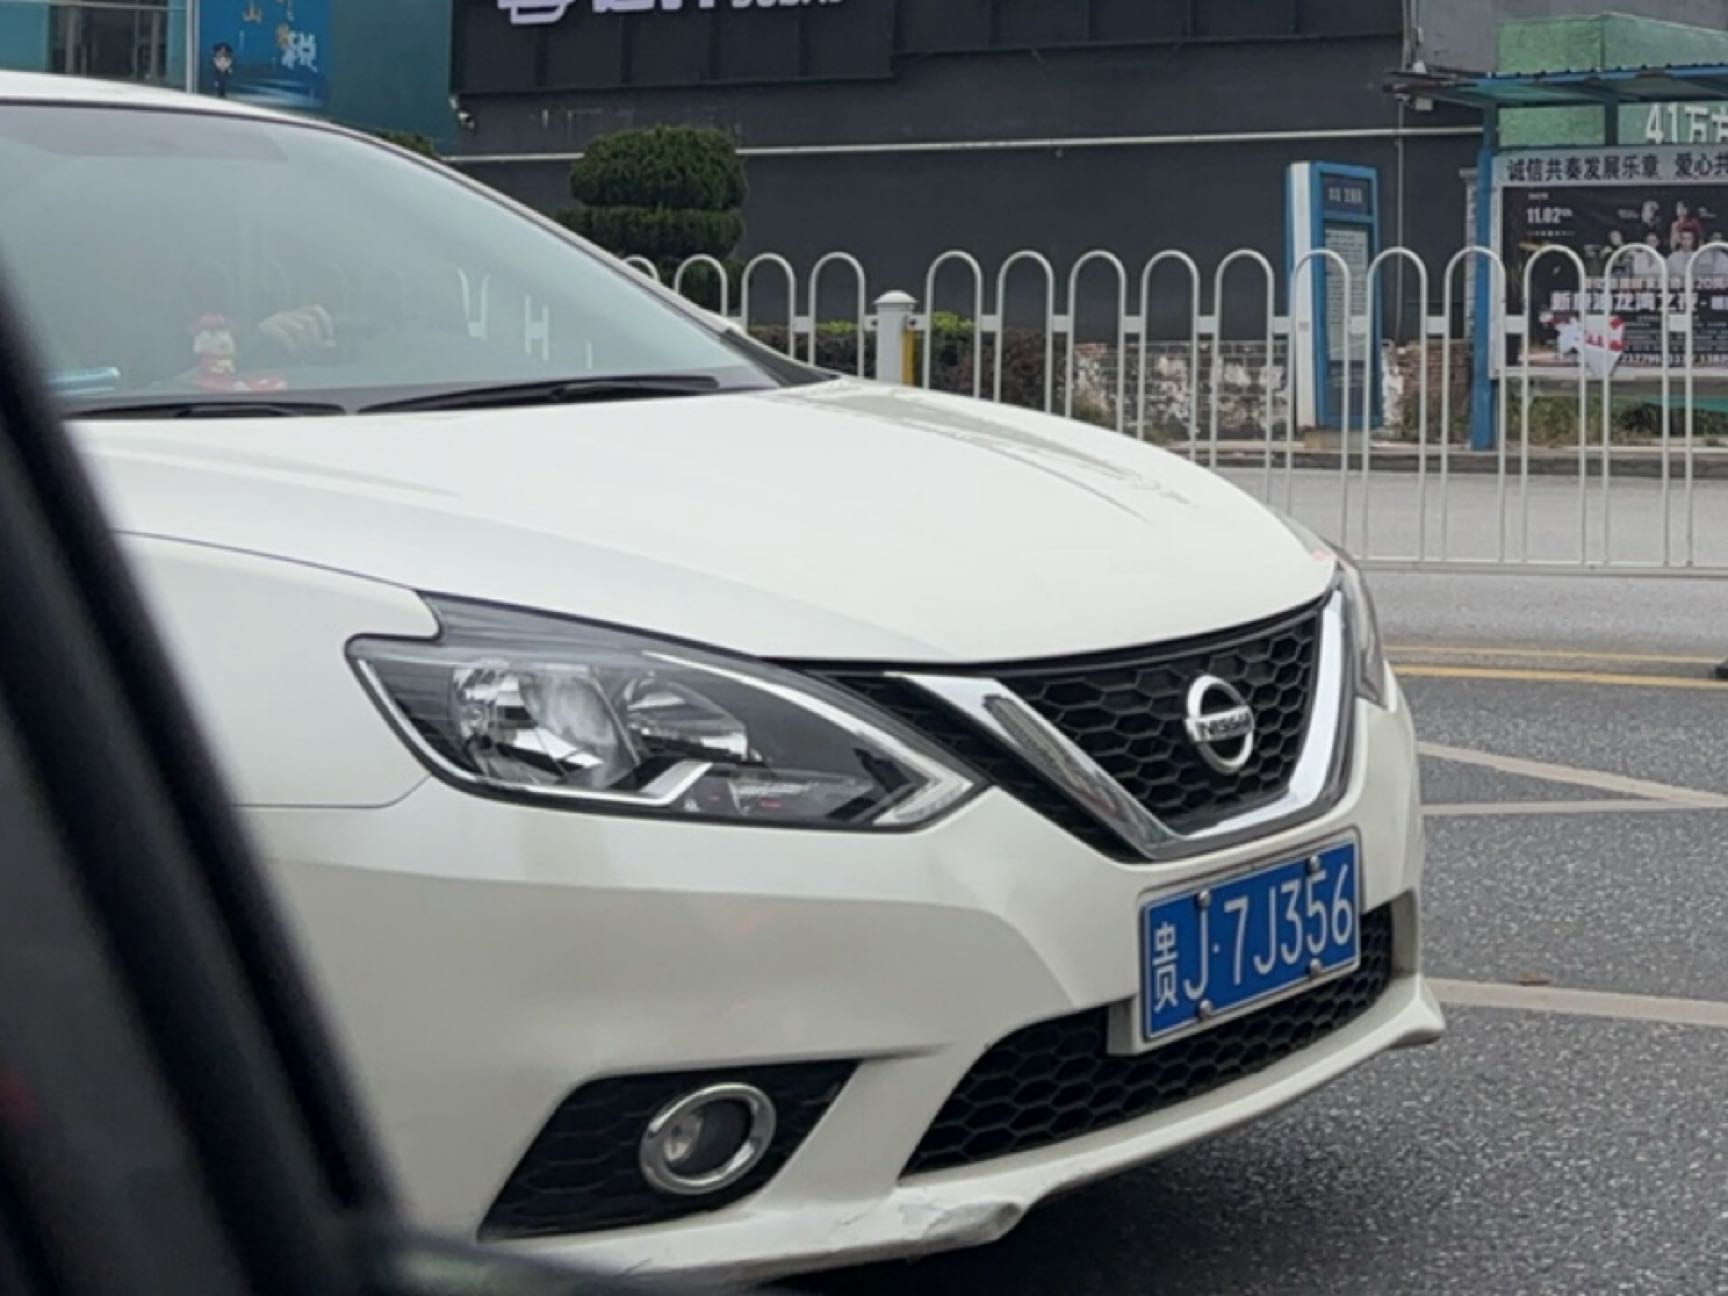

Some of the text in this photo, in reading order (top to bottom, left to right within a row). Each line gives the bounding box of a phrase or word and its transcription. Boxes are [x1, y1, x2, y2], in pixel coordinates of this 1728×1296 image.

[1507, 153, 1660, 183] 诚信共奏发展乐章
